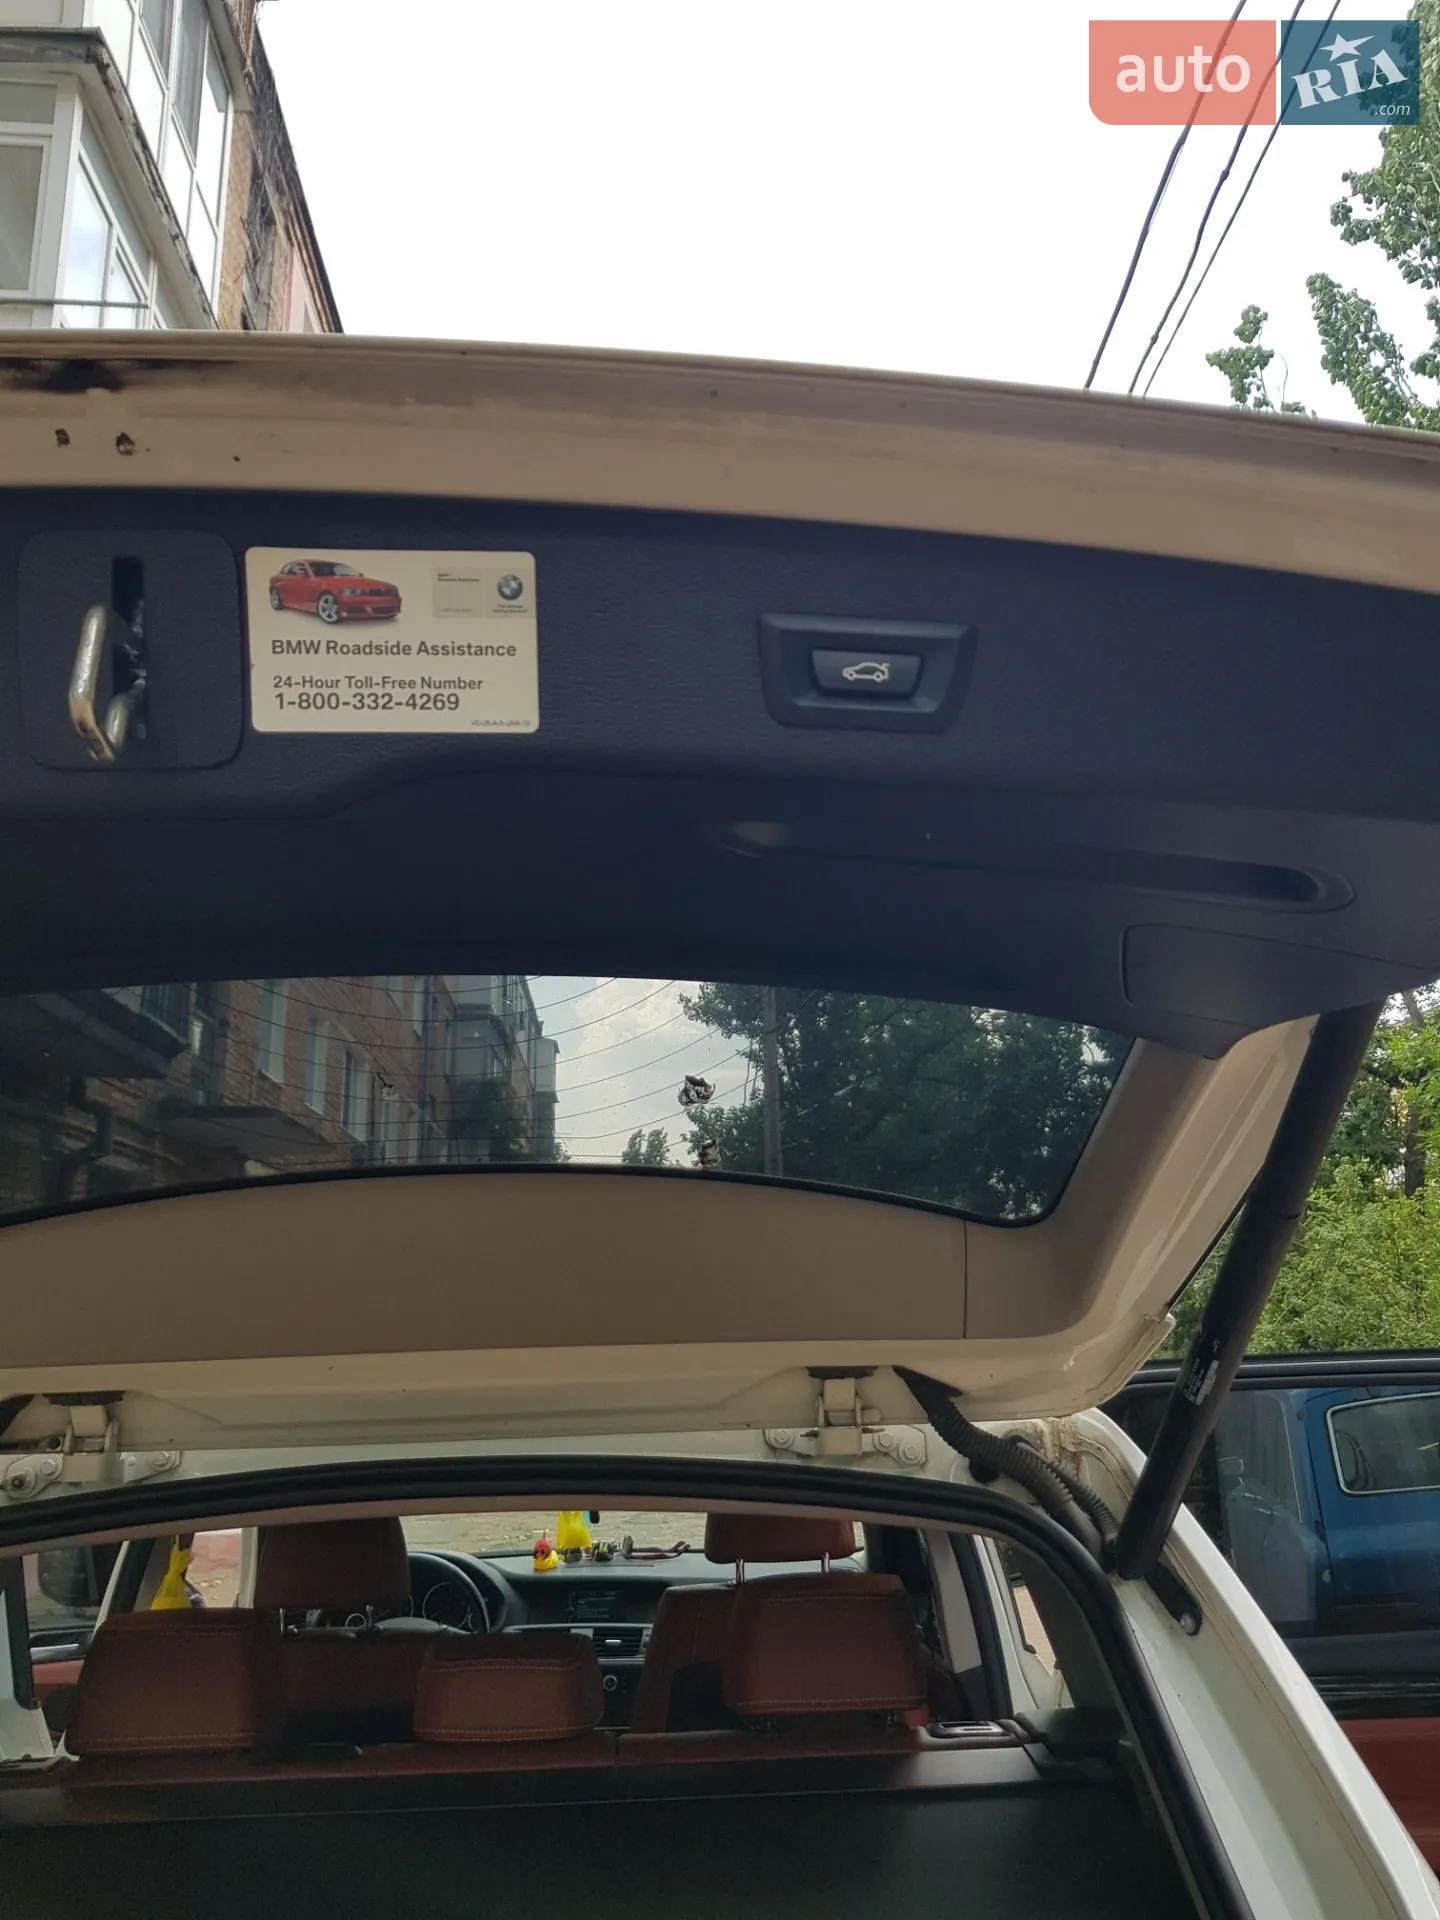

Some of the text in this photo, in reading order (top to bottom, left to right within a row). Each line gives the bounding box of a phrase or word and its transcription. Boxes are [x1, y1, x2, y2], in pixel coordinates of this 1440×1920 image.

[271, 640, 517, 657] BMW Roadside Assistance
[272, 675, 484, 691] 24-Hour Toll-Free Number
[275, 692, 460, 711] 1-800-332-4269
